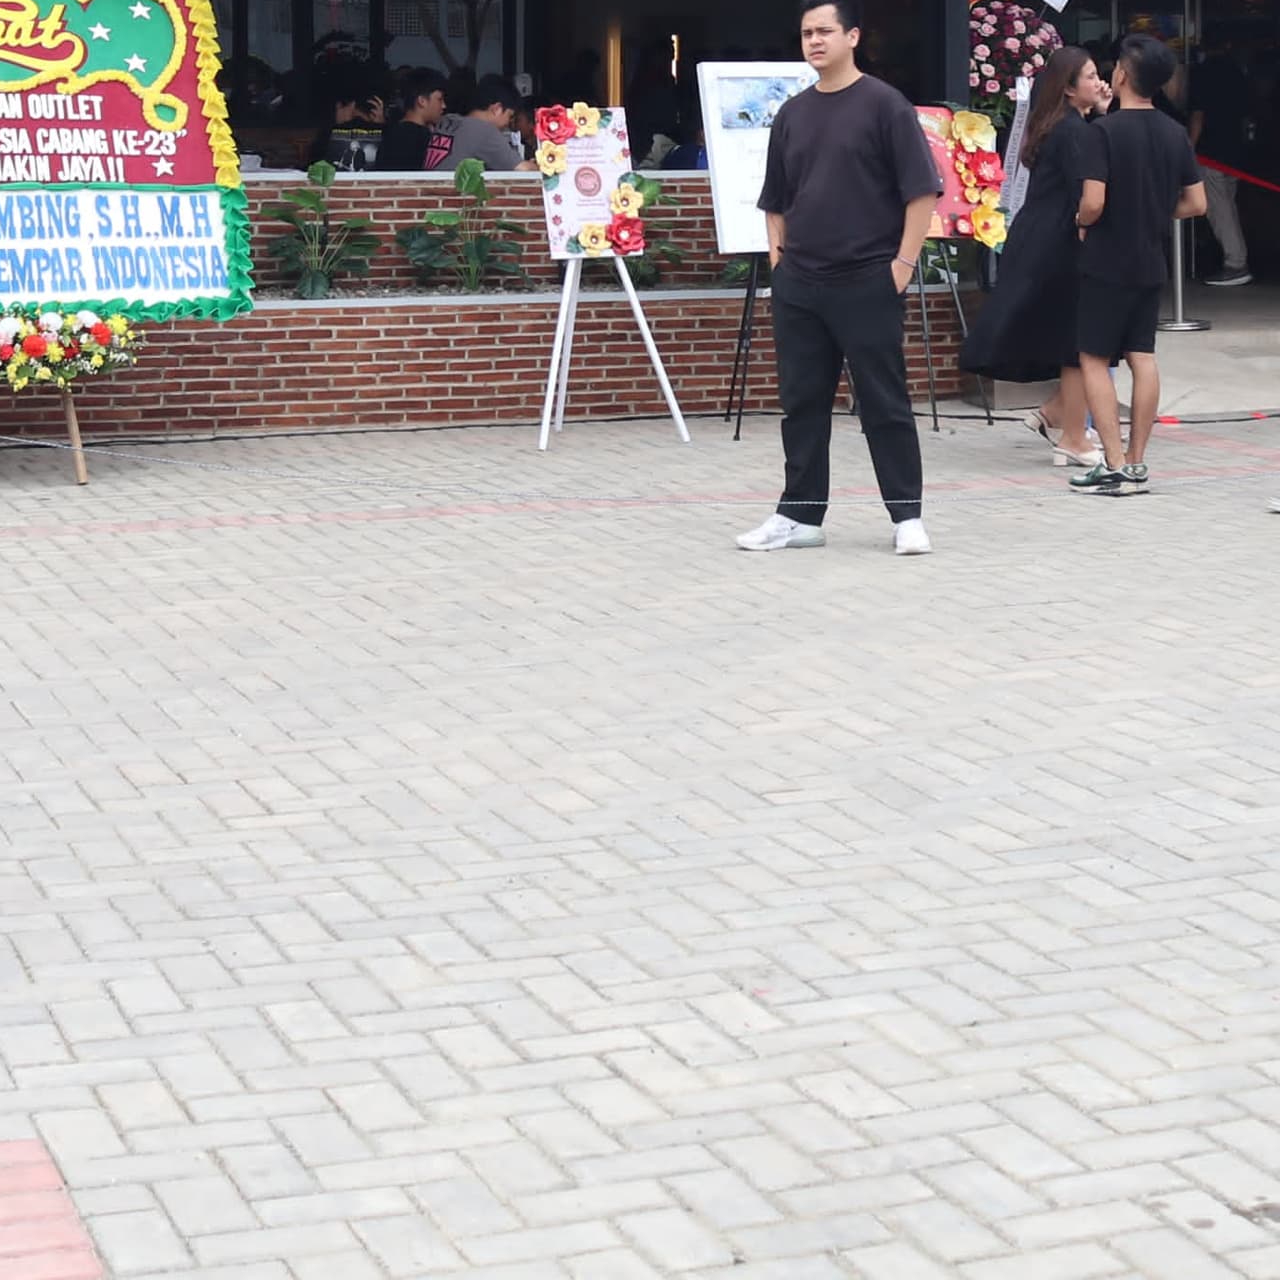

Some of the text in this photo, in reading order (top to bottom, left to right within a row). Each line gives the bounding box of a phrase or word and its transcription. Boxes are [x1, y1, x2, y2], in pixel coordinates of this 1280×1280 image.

[27, 93, 104, 121] OUTLET
[35, 128, 110, 155] CABANG
[91, 244, 230, 291] INDONESIA
